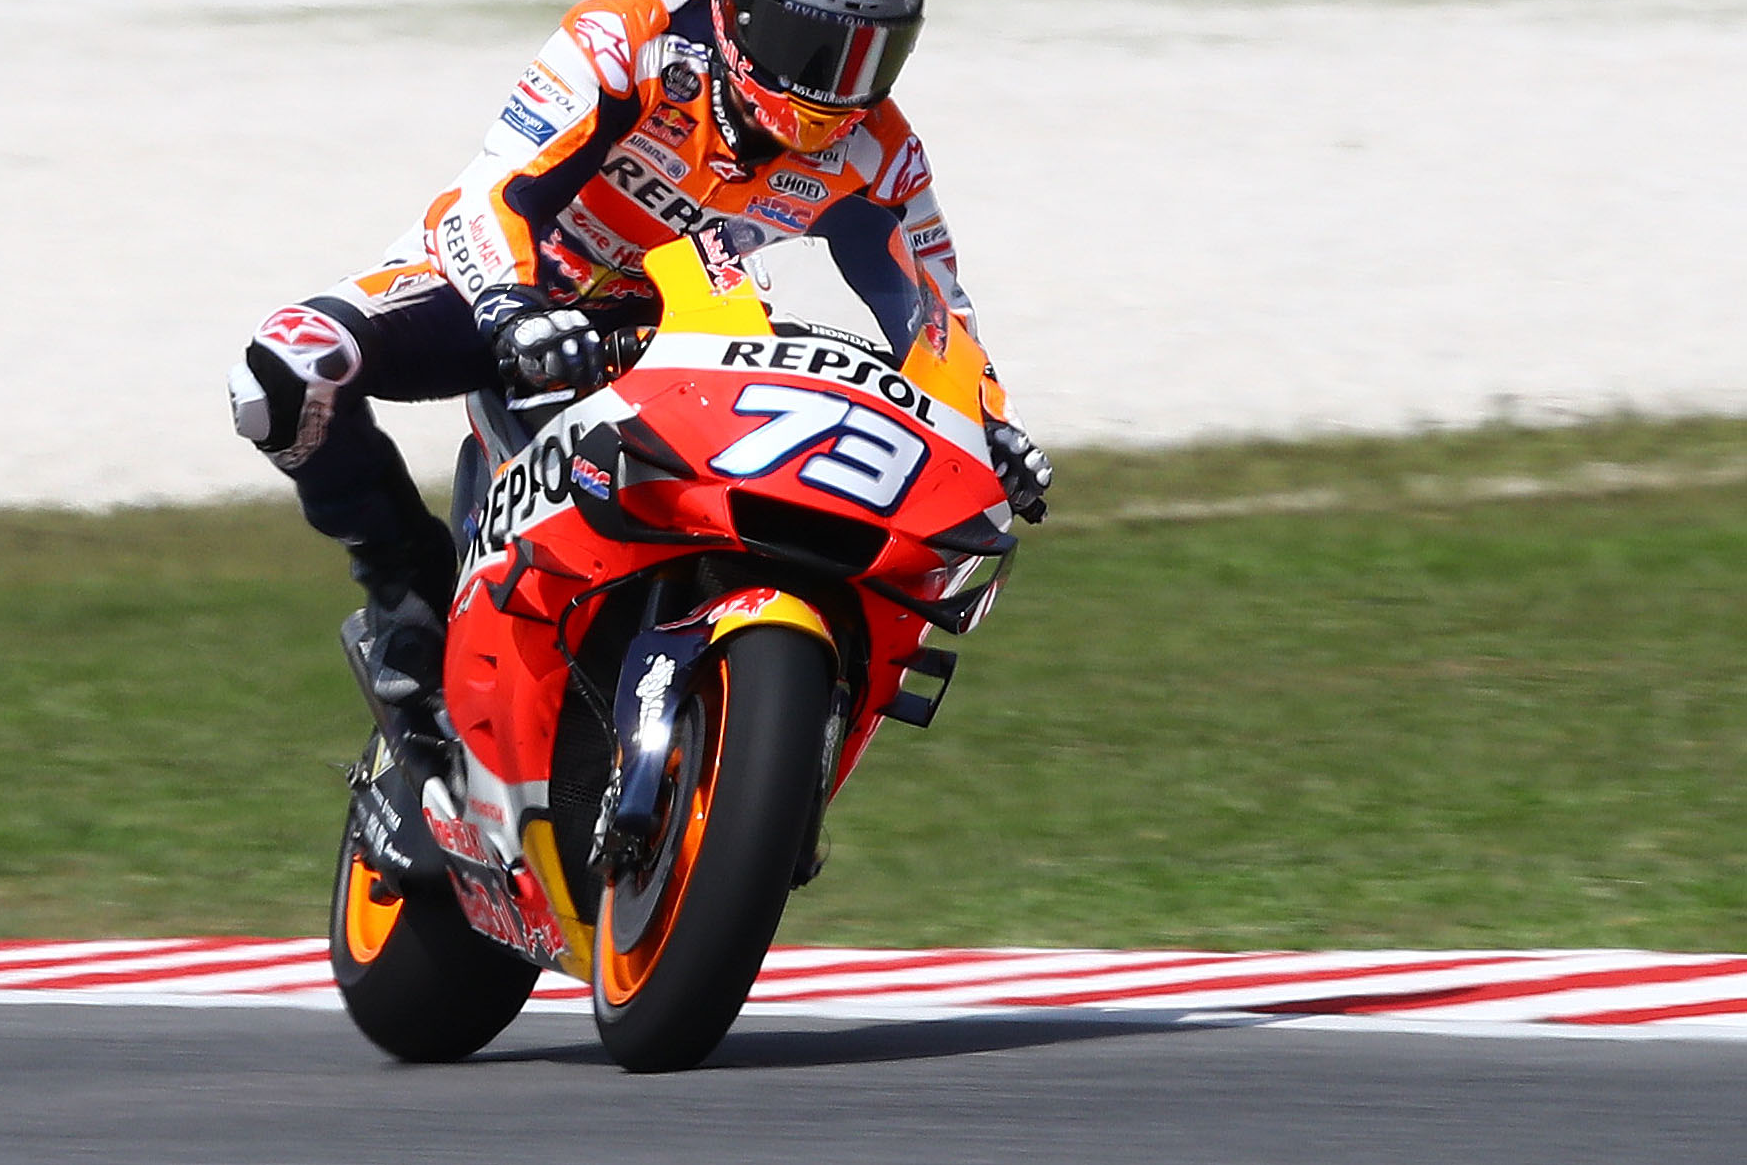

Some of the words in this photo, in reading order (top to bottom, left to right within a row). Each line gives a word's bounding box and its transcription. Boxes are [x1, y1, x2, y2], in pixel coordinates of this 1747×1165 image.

[523, 67, 576, 113] REPSOL
[626, 134, 667, 165] Allianz
[773, 174, 820, 199] SHOEI
[746, 195, 813, 231] HRC
[443, 215, 484, 293] REPSO
[811, 324, 872, 350] HONDA
[721, 341, 935, 427] REPSOL
[709, 383, 931, 517] 73
